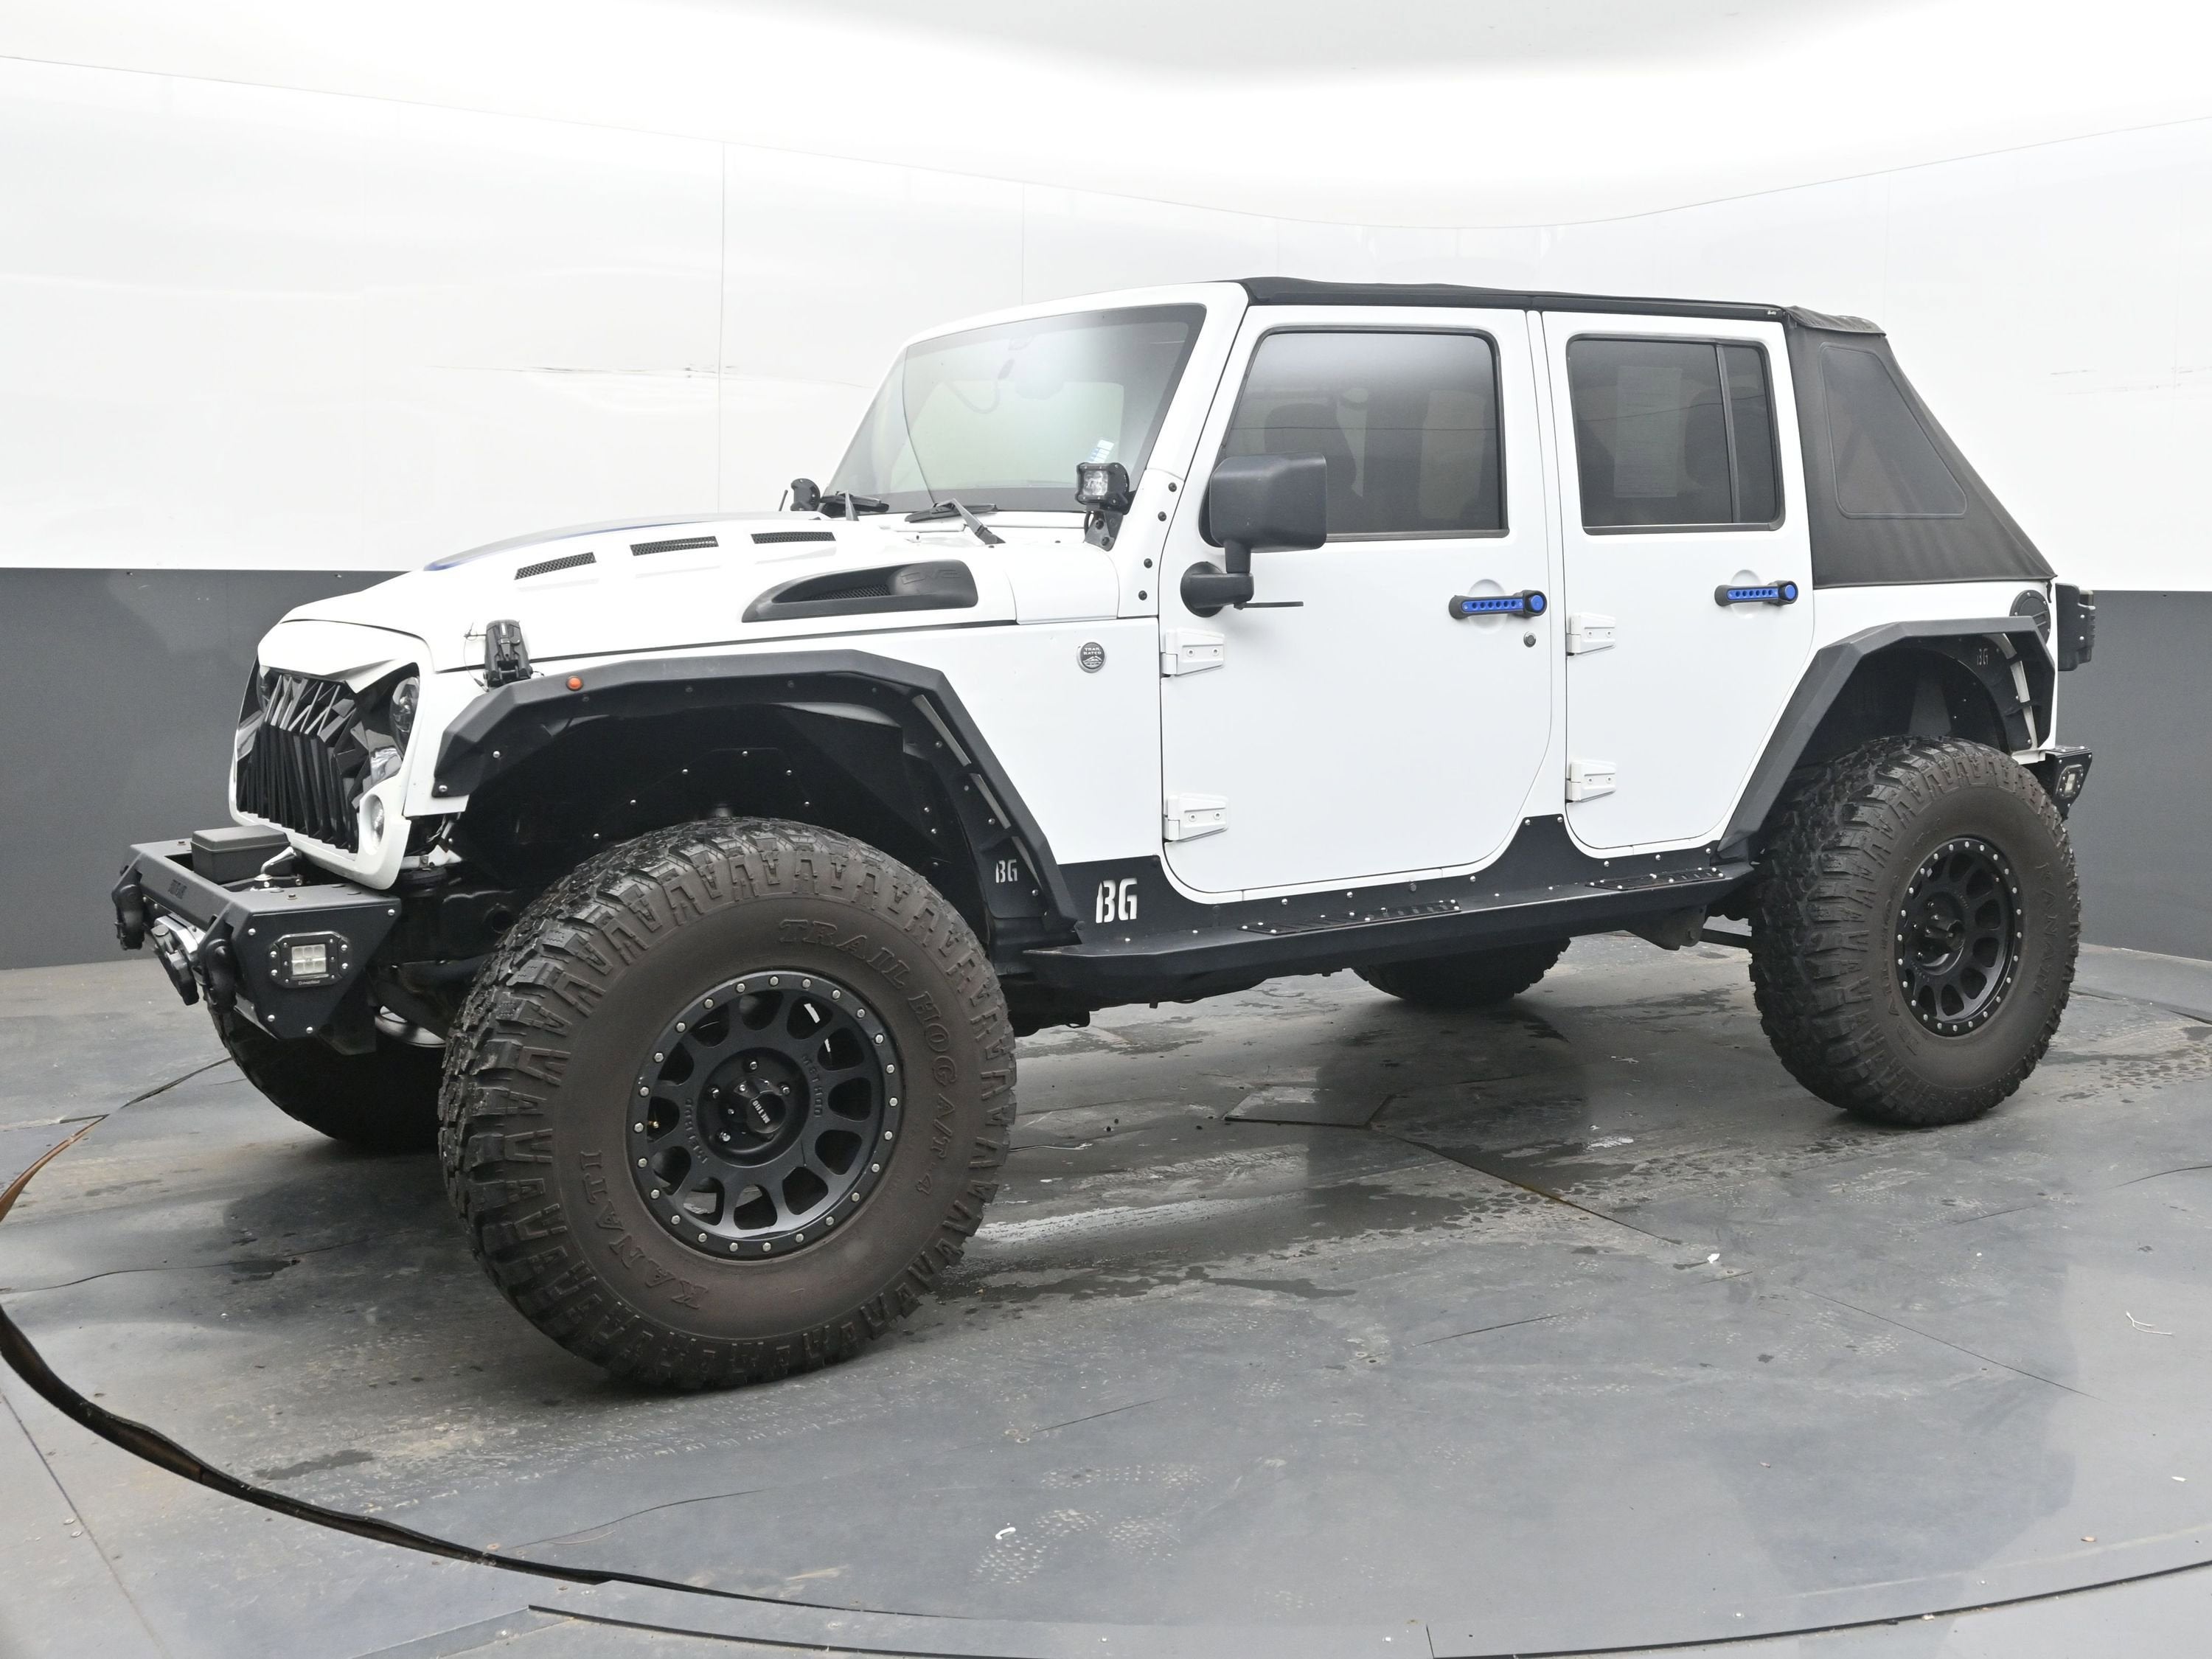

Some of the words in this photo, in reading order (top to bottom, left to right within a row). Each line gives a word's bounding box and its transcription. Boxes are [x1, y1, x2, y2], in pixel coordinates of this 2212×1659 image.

[995, 859, 1018, 883] BG
[1096, 877, 1138, 924] BG
[779, 919, 911, 990] TRAIL
[908, 990, 957, 1086] HOG
[580, 1150, 709, 1310] KANATI
